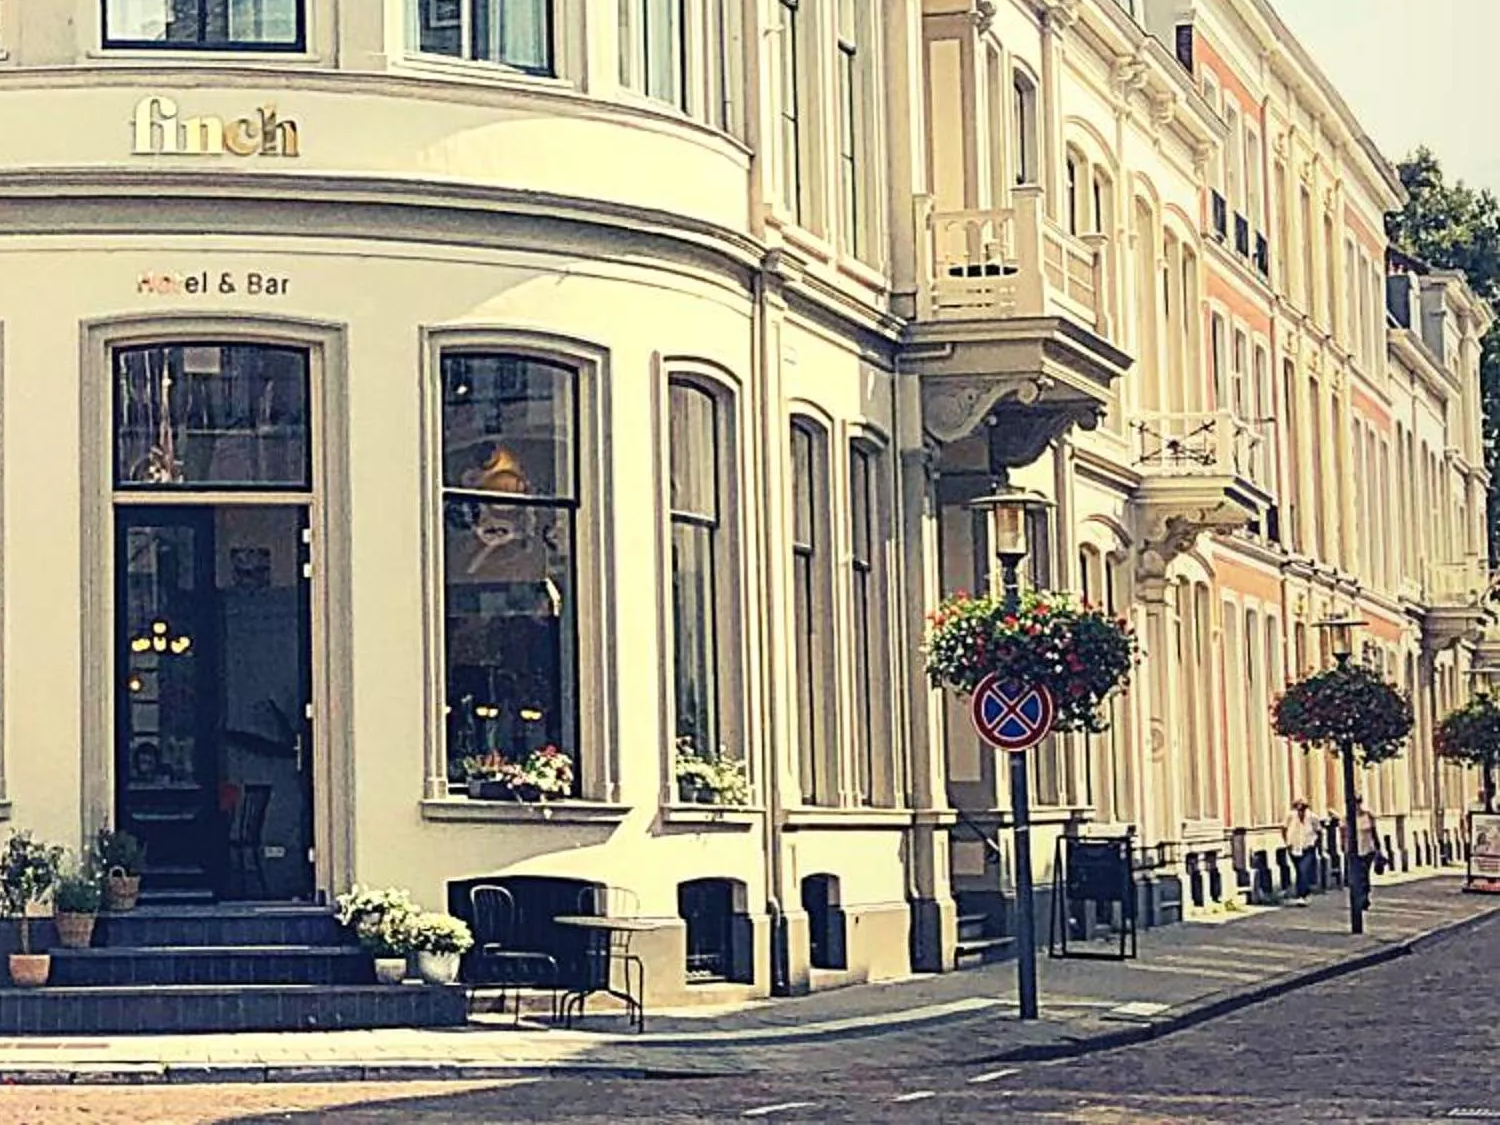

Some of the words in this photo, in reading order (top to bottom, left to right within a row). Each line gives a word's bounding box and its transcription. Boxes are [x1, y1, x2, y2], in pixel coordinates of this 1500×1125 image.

[130, 95, 300, 158] finch
[218, 272, 237, 294] &
[247, 272, 290, 295] Bar
